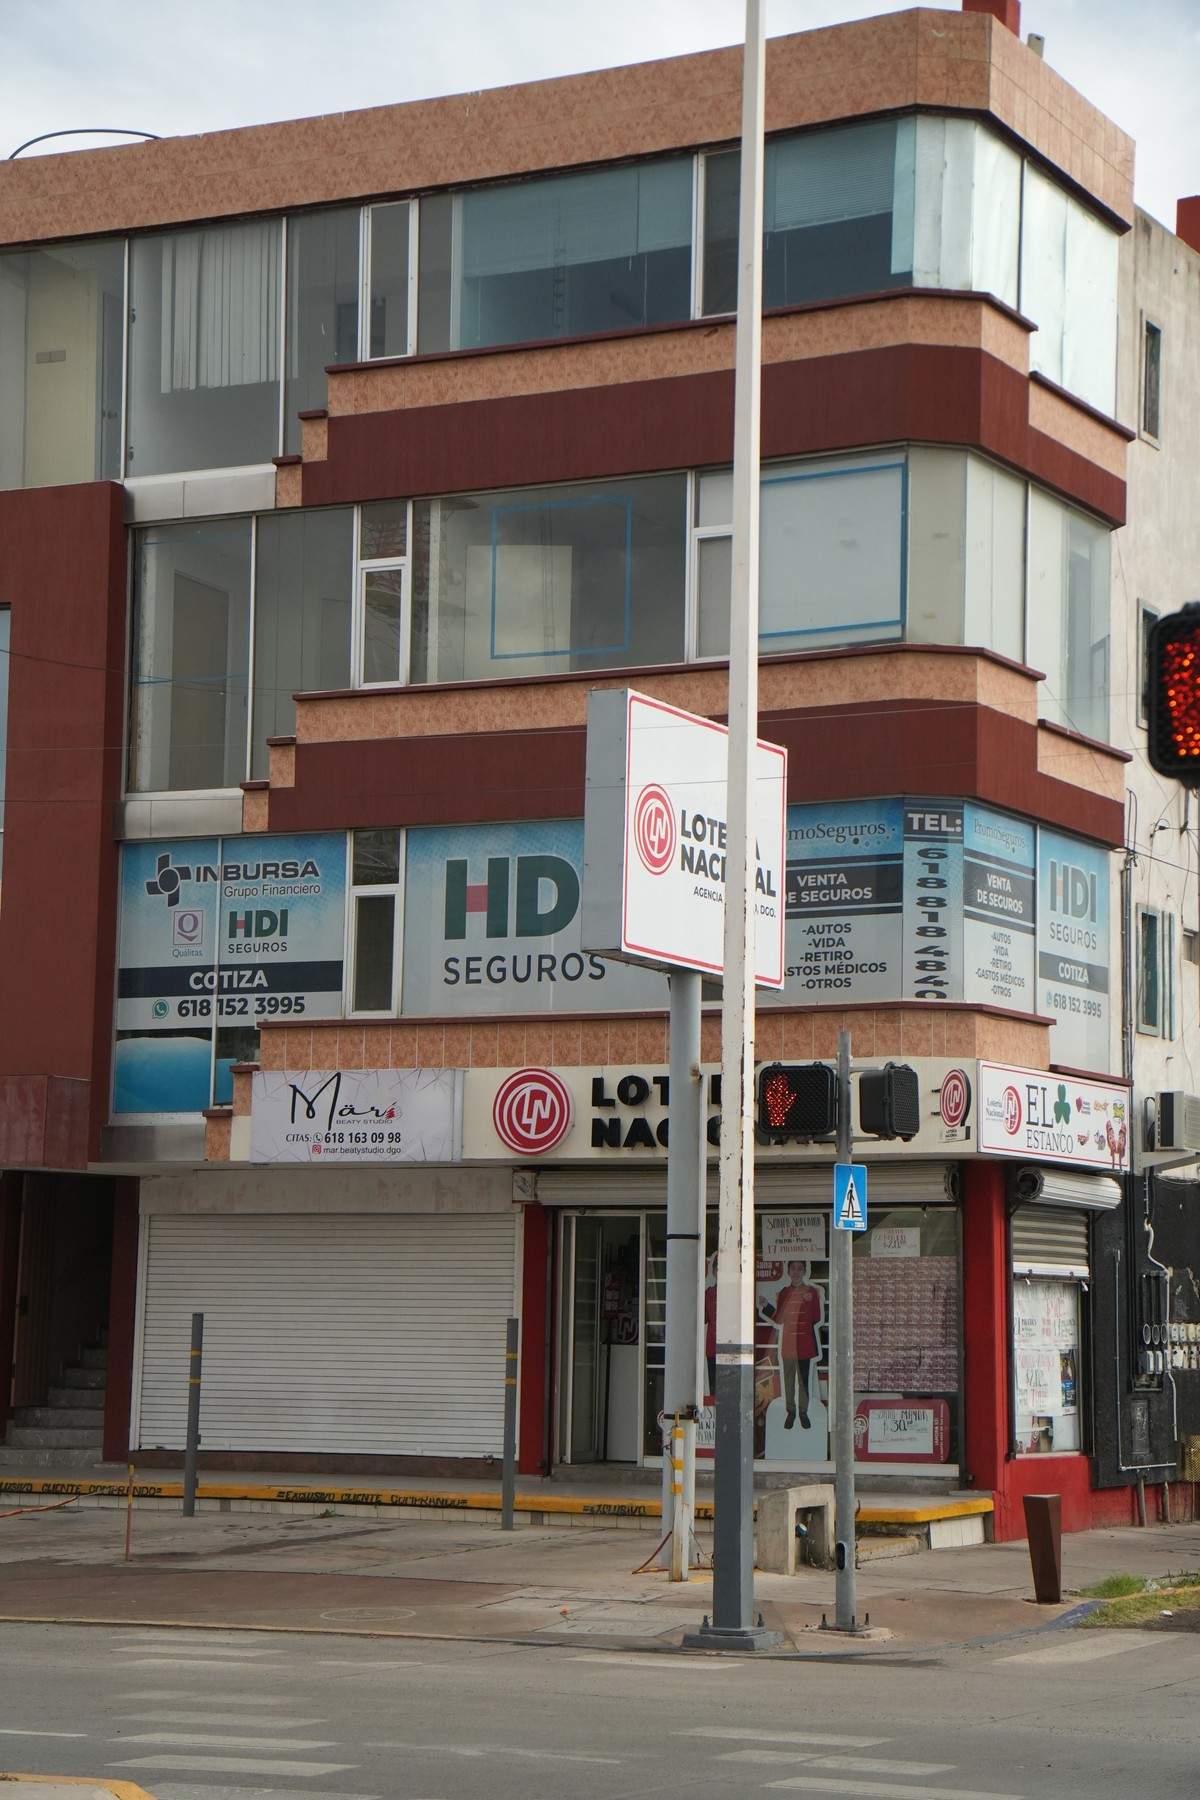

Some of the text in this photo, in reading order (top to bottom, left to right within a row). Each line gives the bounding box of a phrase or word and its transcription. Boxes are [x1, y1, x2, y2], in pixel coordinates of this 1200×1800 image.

[907, 813, 962, 832] TEL:
[681, 810, 760, 860] LOTE
[786, 823, 886, 843] moSeguros
[196, 861, 320, 882] INBURSA
[681, 844, 776, 897] NACIAL
[797, 873, 848, 888] VENTA
[223, 883, 320, 899] Grupo Financiero
[986, 873, 1012, 893] VENTA
[1050, 860, 1097, 923] HDI
[694, 886, 723, 904] AGENCIA
[801, 887, 873, 903] SEGUROS
[977, 889, 1023, 914] DE SEGUROS
[228, 908, 288, 938] HDI
[801, 923, 852, 936] -AUTOS
[808, 937, 846, 949] -VIDA
[1050, 922, 1097, 950] SEGUROS
[228, 942, 288, 954] SEGUROS
[800, 950, 854, 962] -RETIRO
[443, 952, 606, 985] SEGUROS
[784, 961, 887, 976] STOS MÉDICOS
[1058, 962, 1089, 984] COTIZA
[189, 970, 268, 990] COTIZA
[801, 977, 852, 989] -OTROS
[177, 996, 306, 1017] 618 152 3995
[1053, 993, 1102, 1018] 618 152 3995
[1026, 1084, 1054, 1128] EL
[324, 1132, 344, 1143] 618
[348, 1132, 367, 1143] 163
[371, 1132, 385, 1143] 09
[387, 1132, 401, 1143] 98
[1026, 1129, 1074, 1154] ESTANCO
[41, 1483, 81, 1494] CLIENTE
[341, 1494, 383, 1504] CLIENTE
